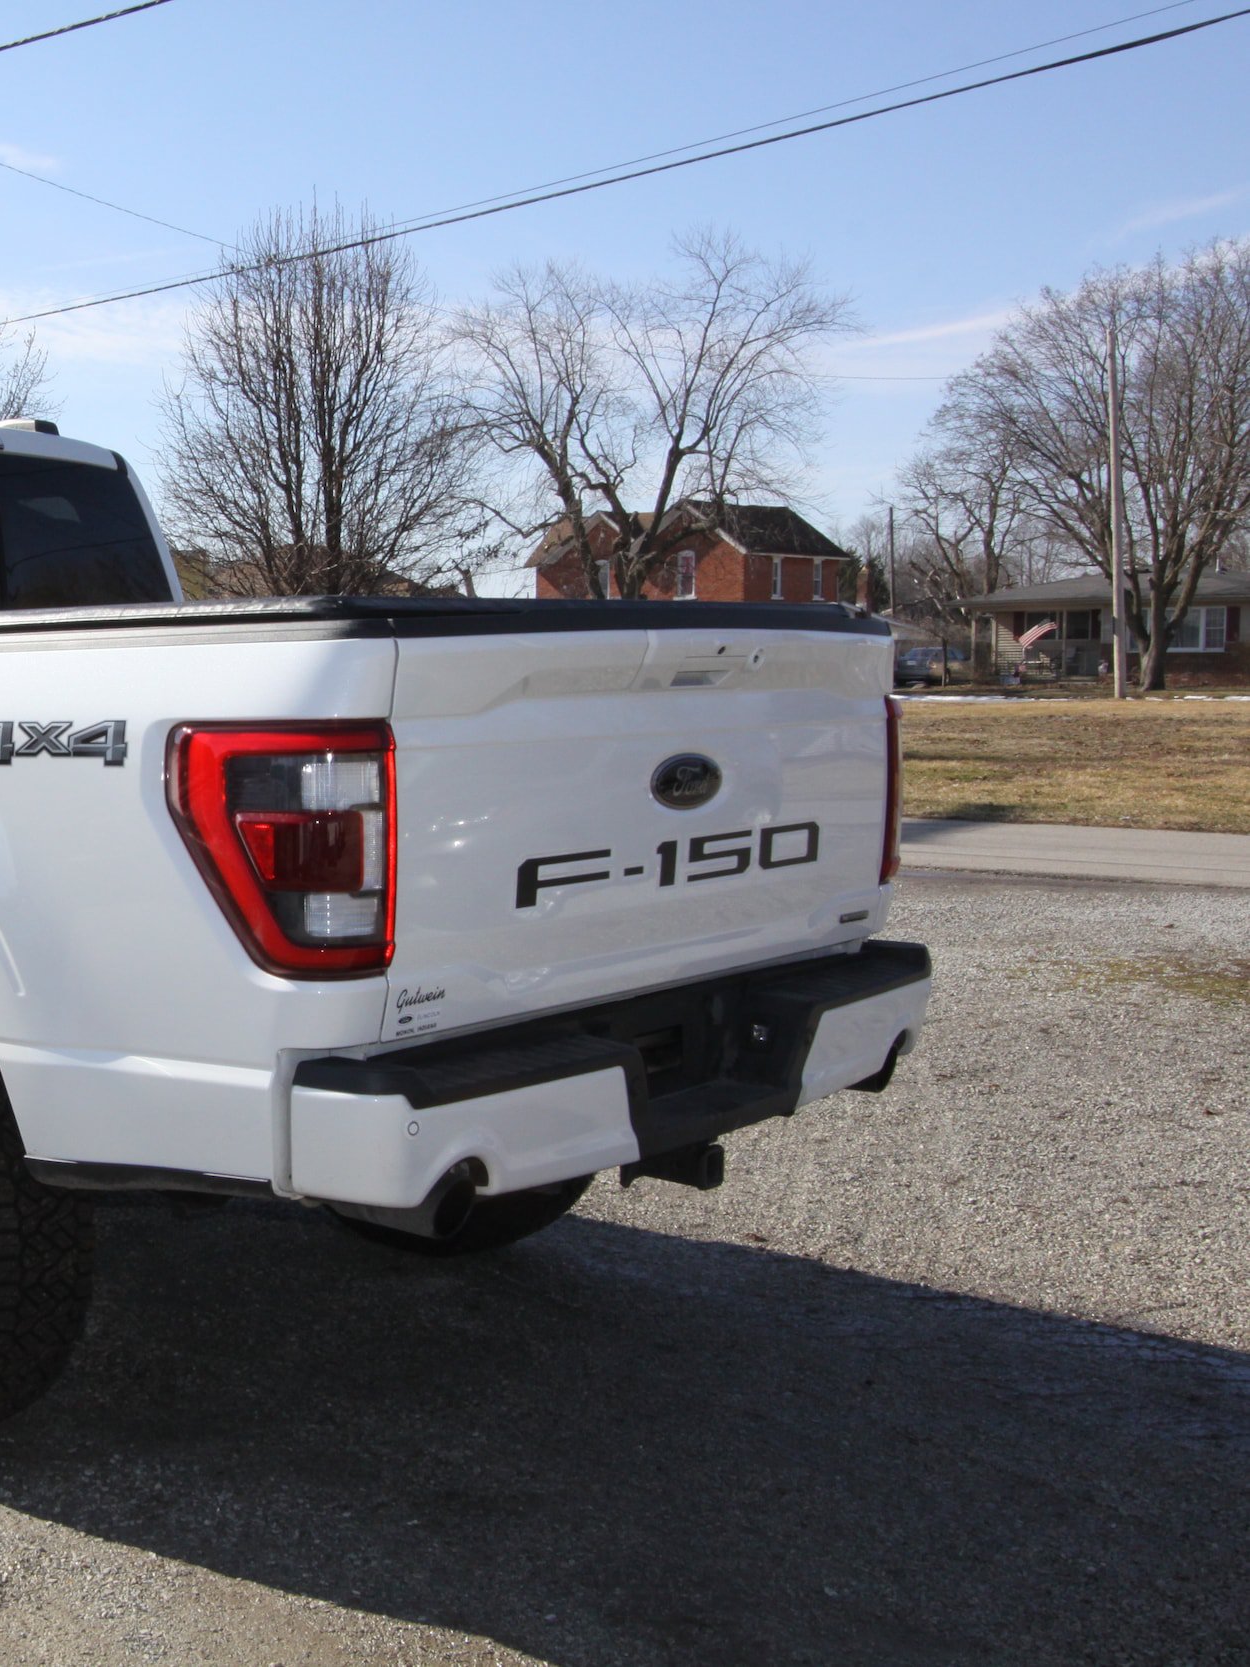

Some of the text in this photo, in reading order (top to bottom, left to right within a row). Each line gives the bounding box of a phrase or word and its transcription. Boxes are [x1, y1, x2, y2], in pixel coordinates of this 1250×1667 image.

[673, 766, 711, 797] Ford
[516, 821, 820, 909] F-150
[396, 986, 446, 1014] Gutwein
